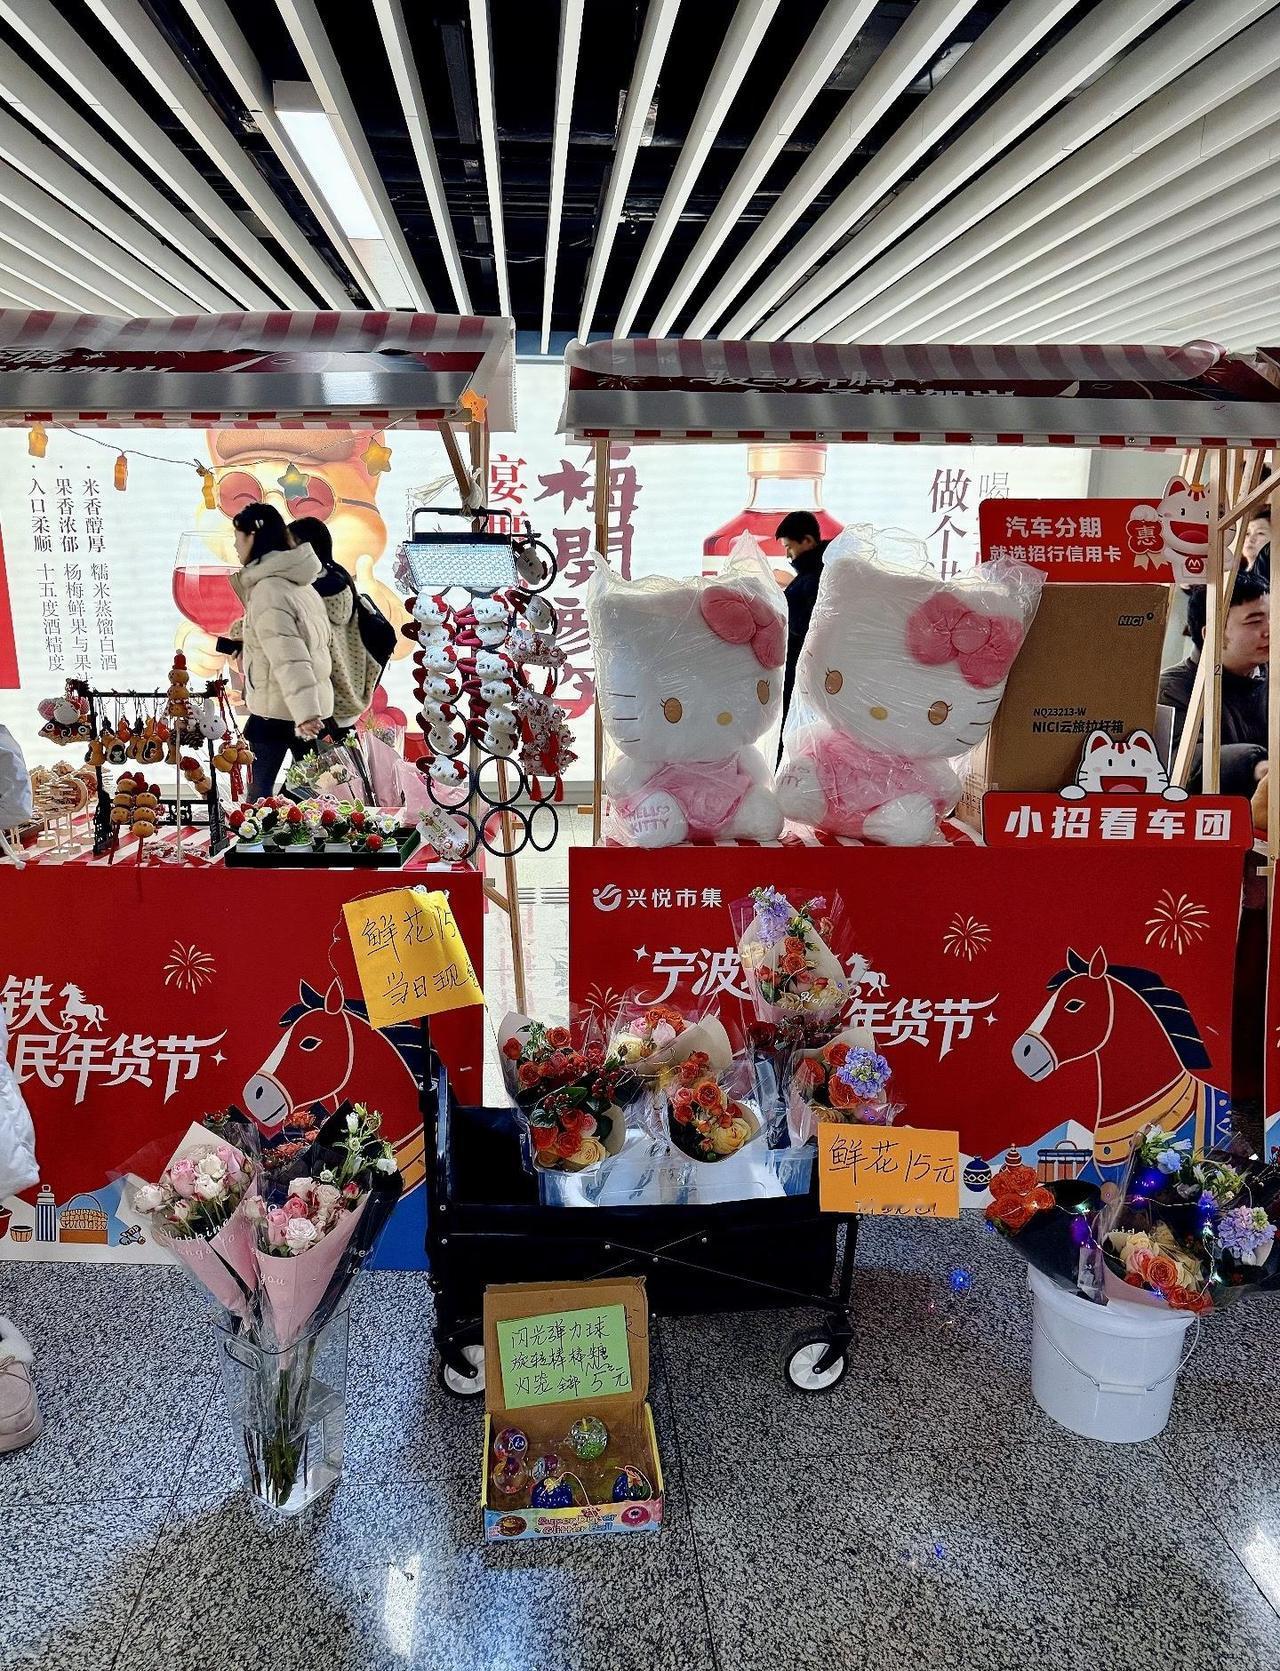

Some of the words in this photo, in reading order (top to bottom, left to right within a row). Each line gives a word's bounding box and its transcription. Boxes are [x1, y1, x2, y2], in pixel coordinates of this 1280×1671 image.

[28, 478, 52, 553] 入口柔顺
[56, 478, 79, 553] 果香浓郁
[82, 478, 106, 553] 米香醇厚
[1006, 516, 1102, 538] 汽车分期
[1136, 524, 1156, 546] 惠
[989, 545, 1122, 563] 就选招行信用卡
[36, 563, 65, 671] 十五度酒精度
[90, 563, 118, 671] 糯米蒸馏白酒
[1117, 614, 1145, 627] NICI
[632, 818, 670, 833] KITTY
[1004, 805, 1231, 841] 小招看车团
[626, 887, 723, 909] 兴悦市集
[634, 946, 752, 1006] 宁波
[5, 1029, 228, 1106] 民年货节
[828, 1133, 956, 1186] 鲜花15元
[511, 1315, 610, 1349] 闪光弹力球
